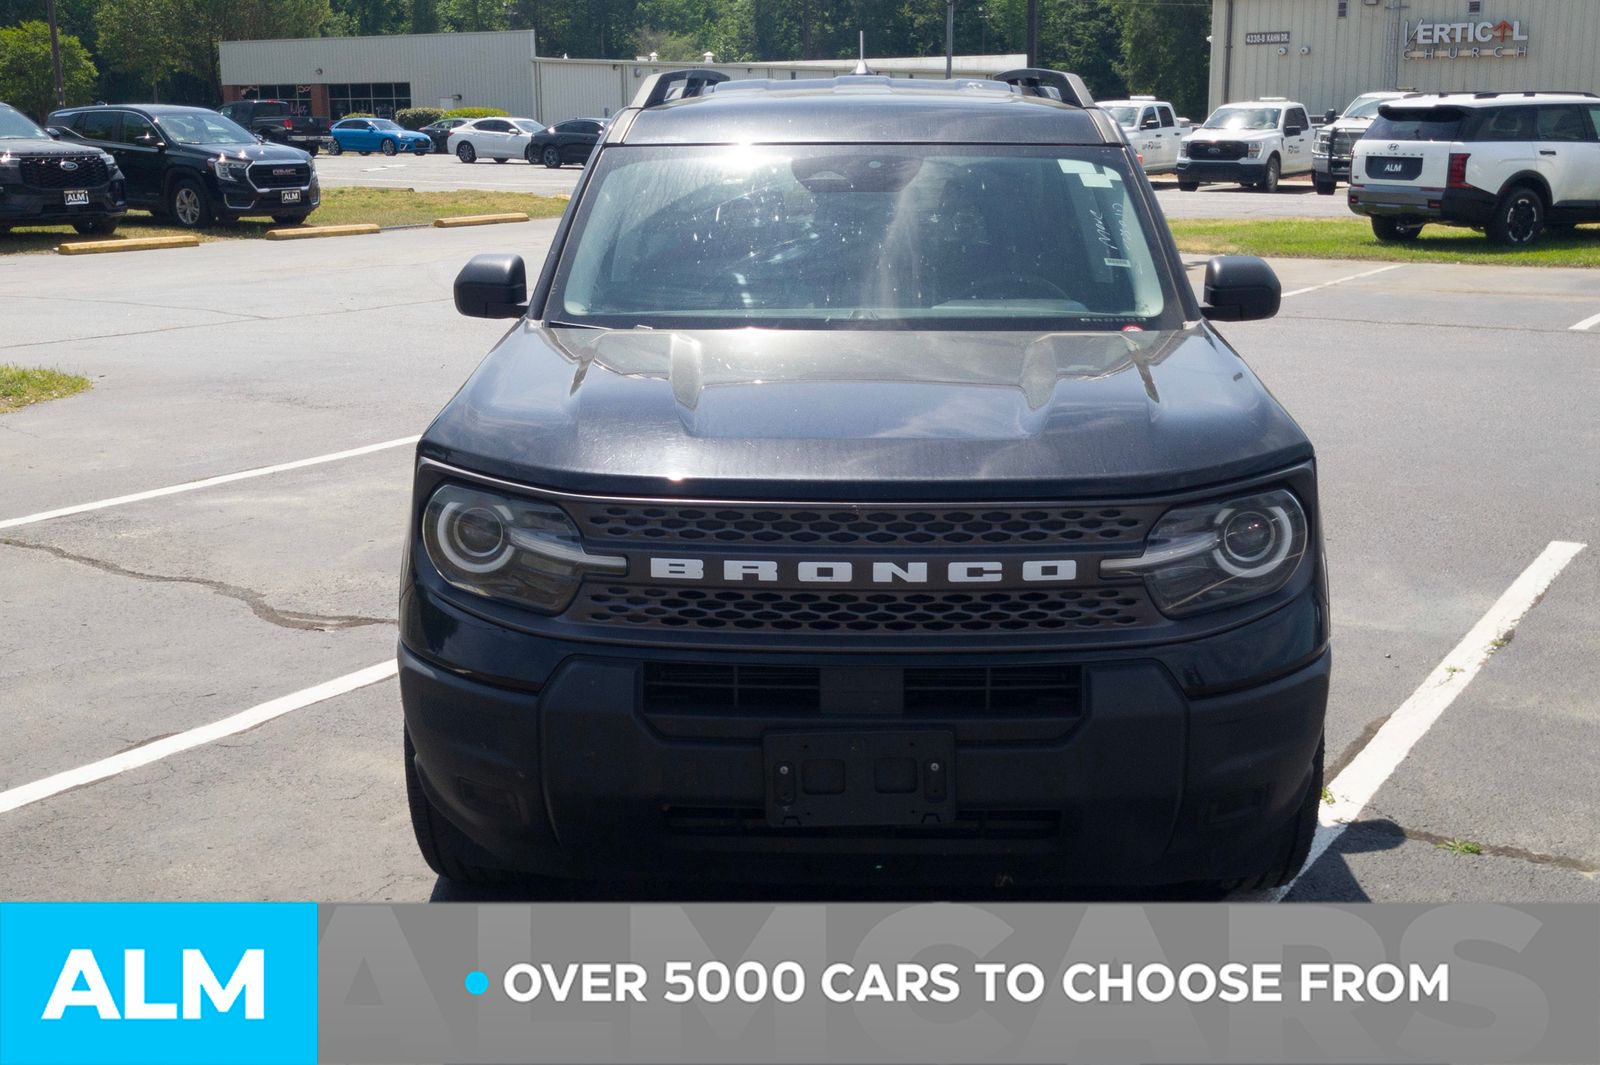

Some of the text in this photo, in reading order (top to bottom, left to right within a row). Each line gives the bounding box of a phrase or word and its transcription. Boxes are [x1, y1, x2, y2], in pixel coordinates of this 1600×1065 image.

[1402, 46, 1528, 60] CHURCH
[272, 168, 297, 176] GMC
[1384, 163, 1403, 172] ALM
[67, 193, 86, 202] ALM
[283, 192, 298, 201] ALM
[650, 556, 1078, 584] BRONCO
